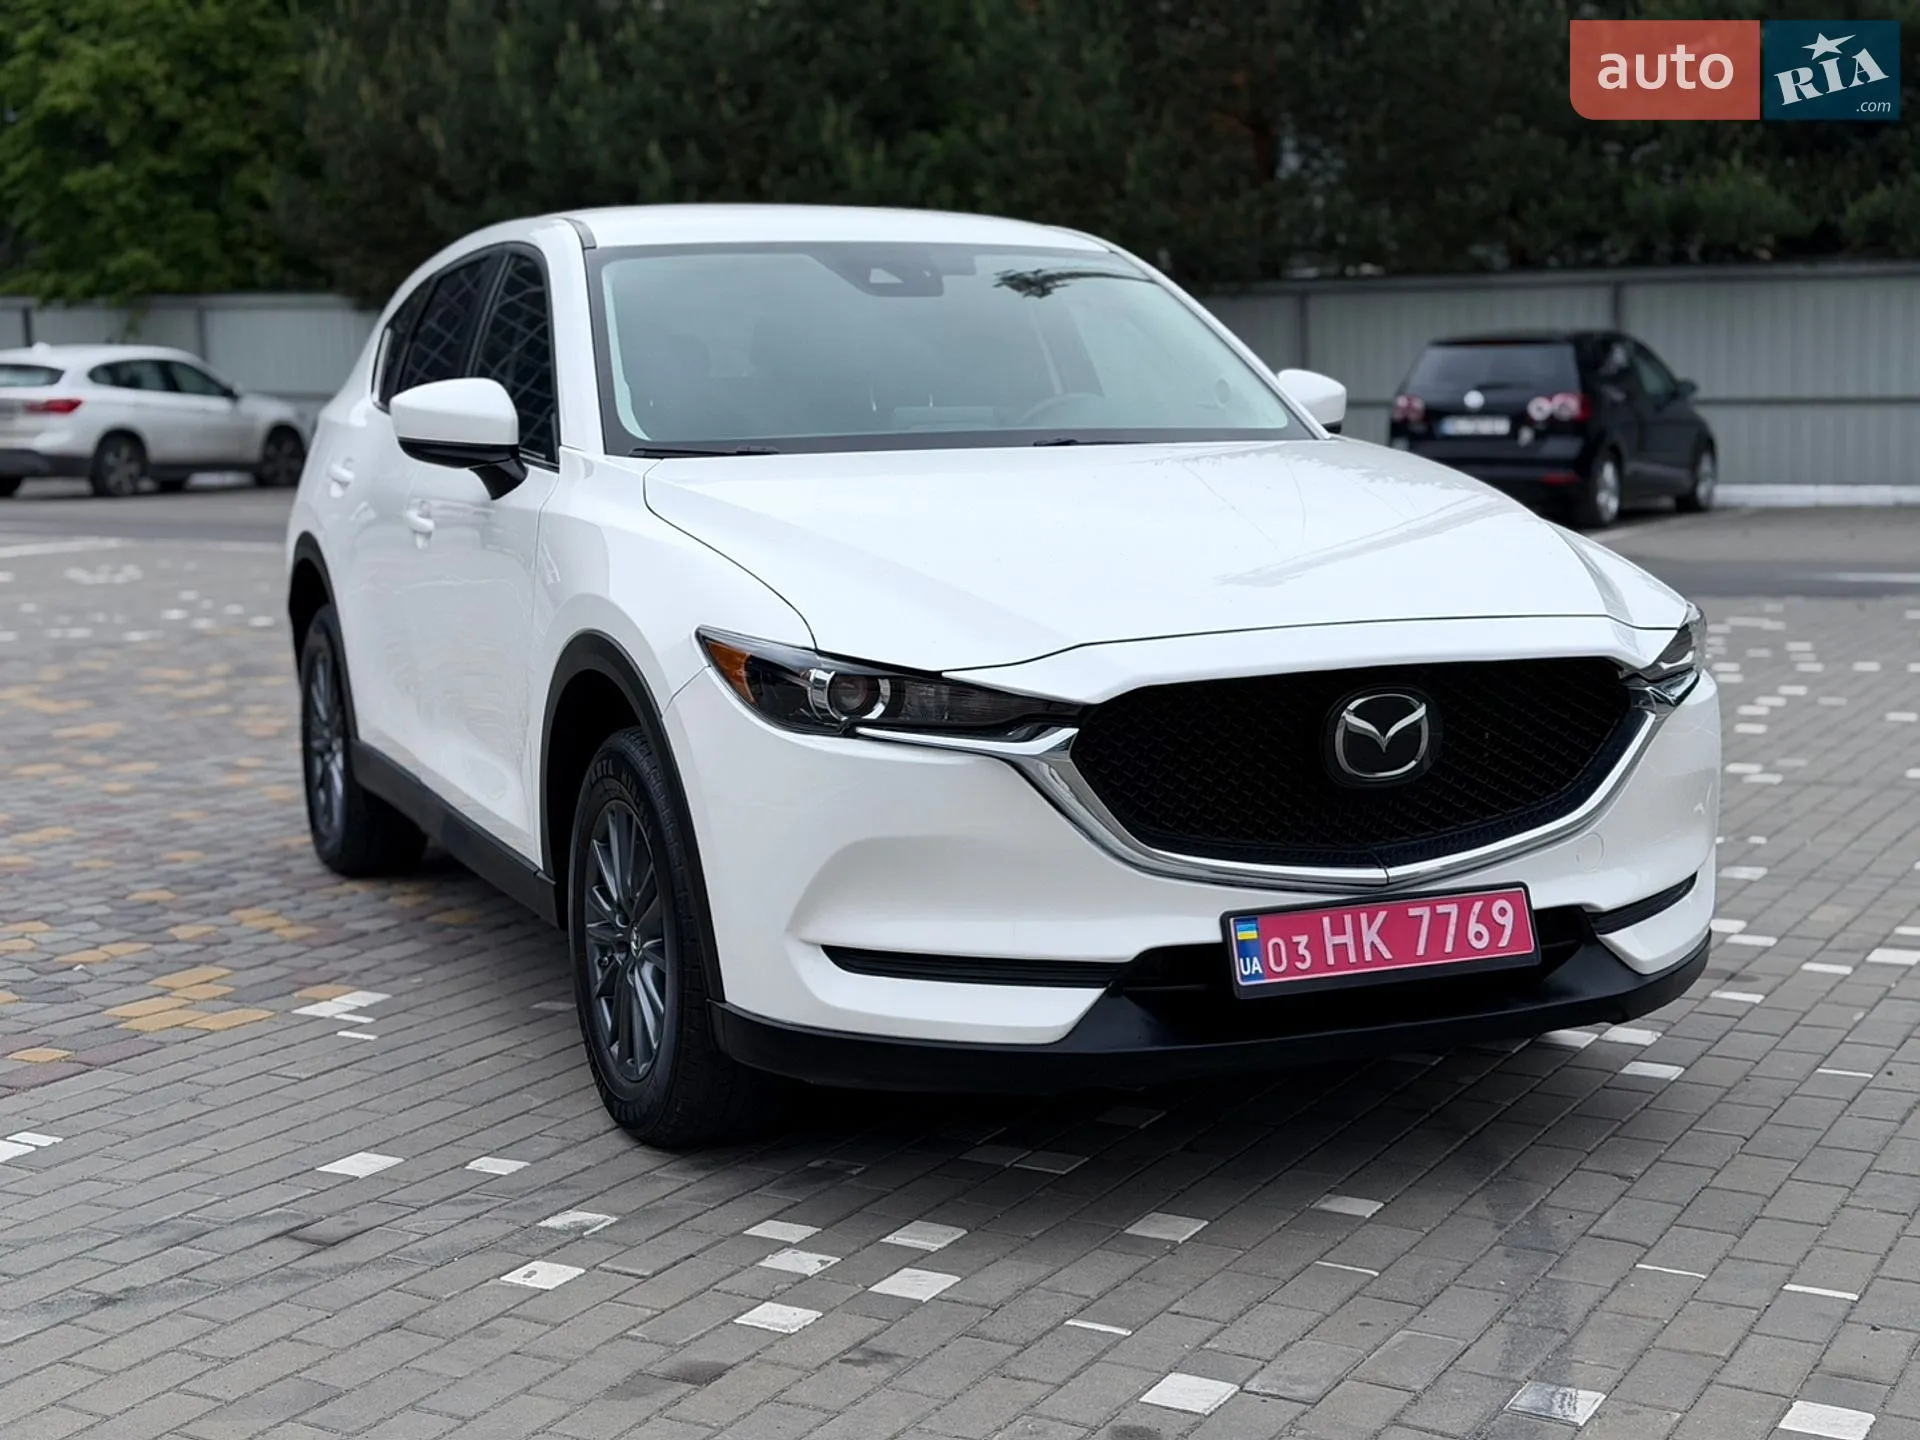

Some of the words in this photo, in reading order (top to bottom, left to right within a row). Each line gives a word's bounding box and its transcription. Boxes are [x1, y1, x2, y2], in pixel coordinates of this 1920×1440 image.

[1267, 935, 1312, 973] 03
[1322, 910, 1393, 966] HK
[1408, 899, 1514, 956] 7769
[1239, 956, 1263, 976] UA
